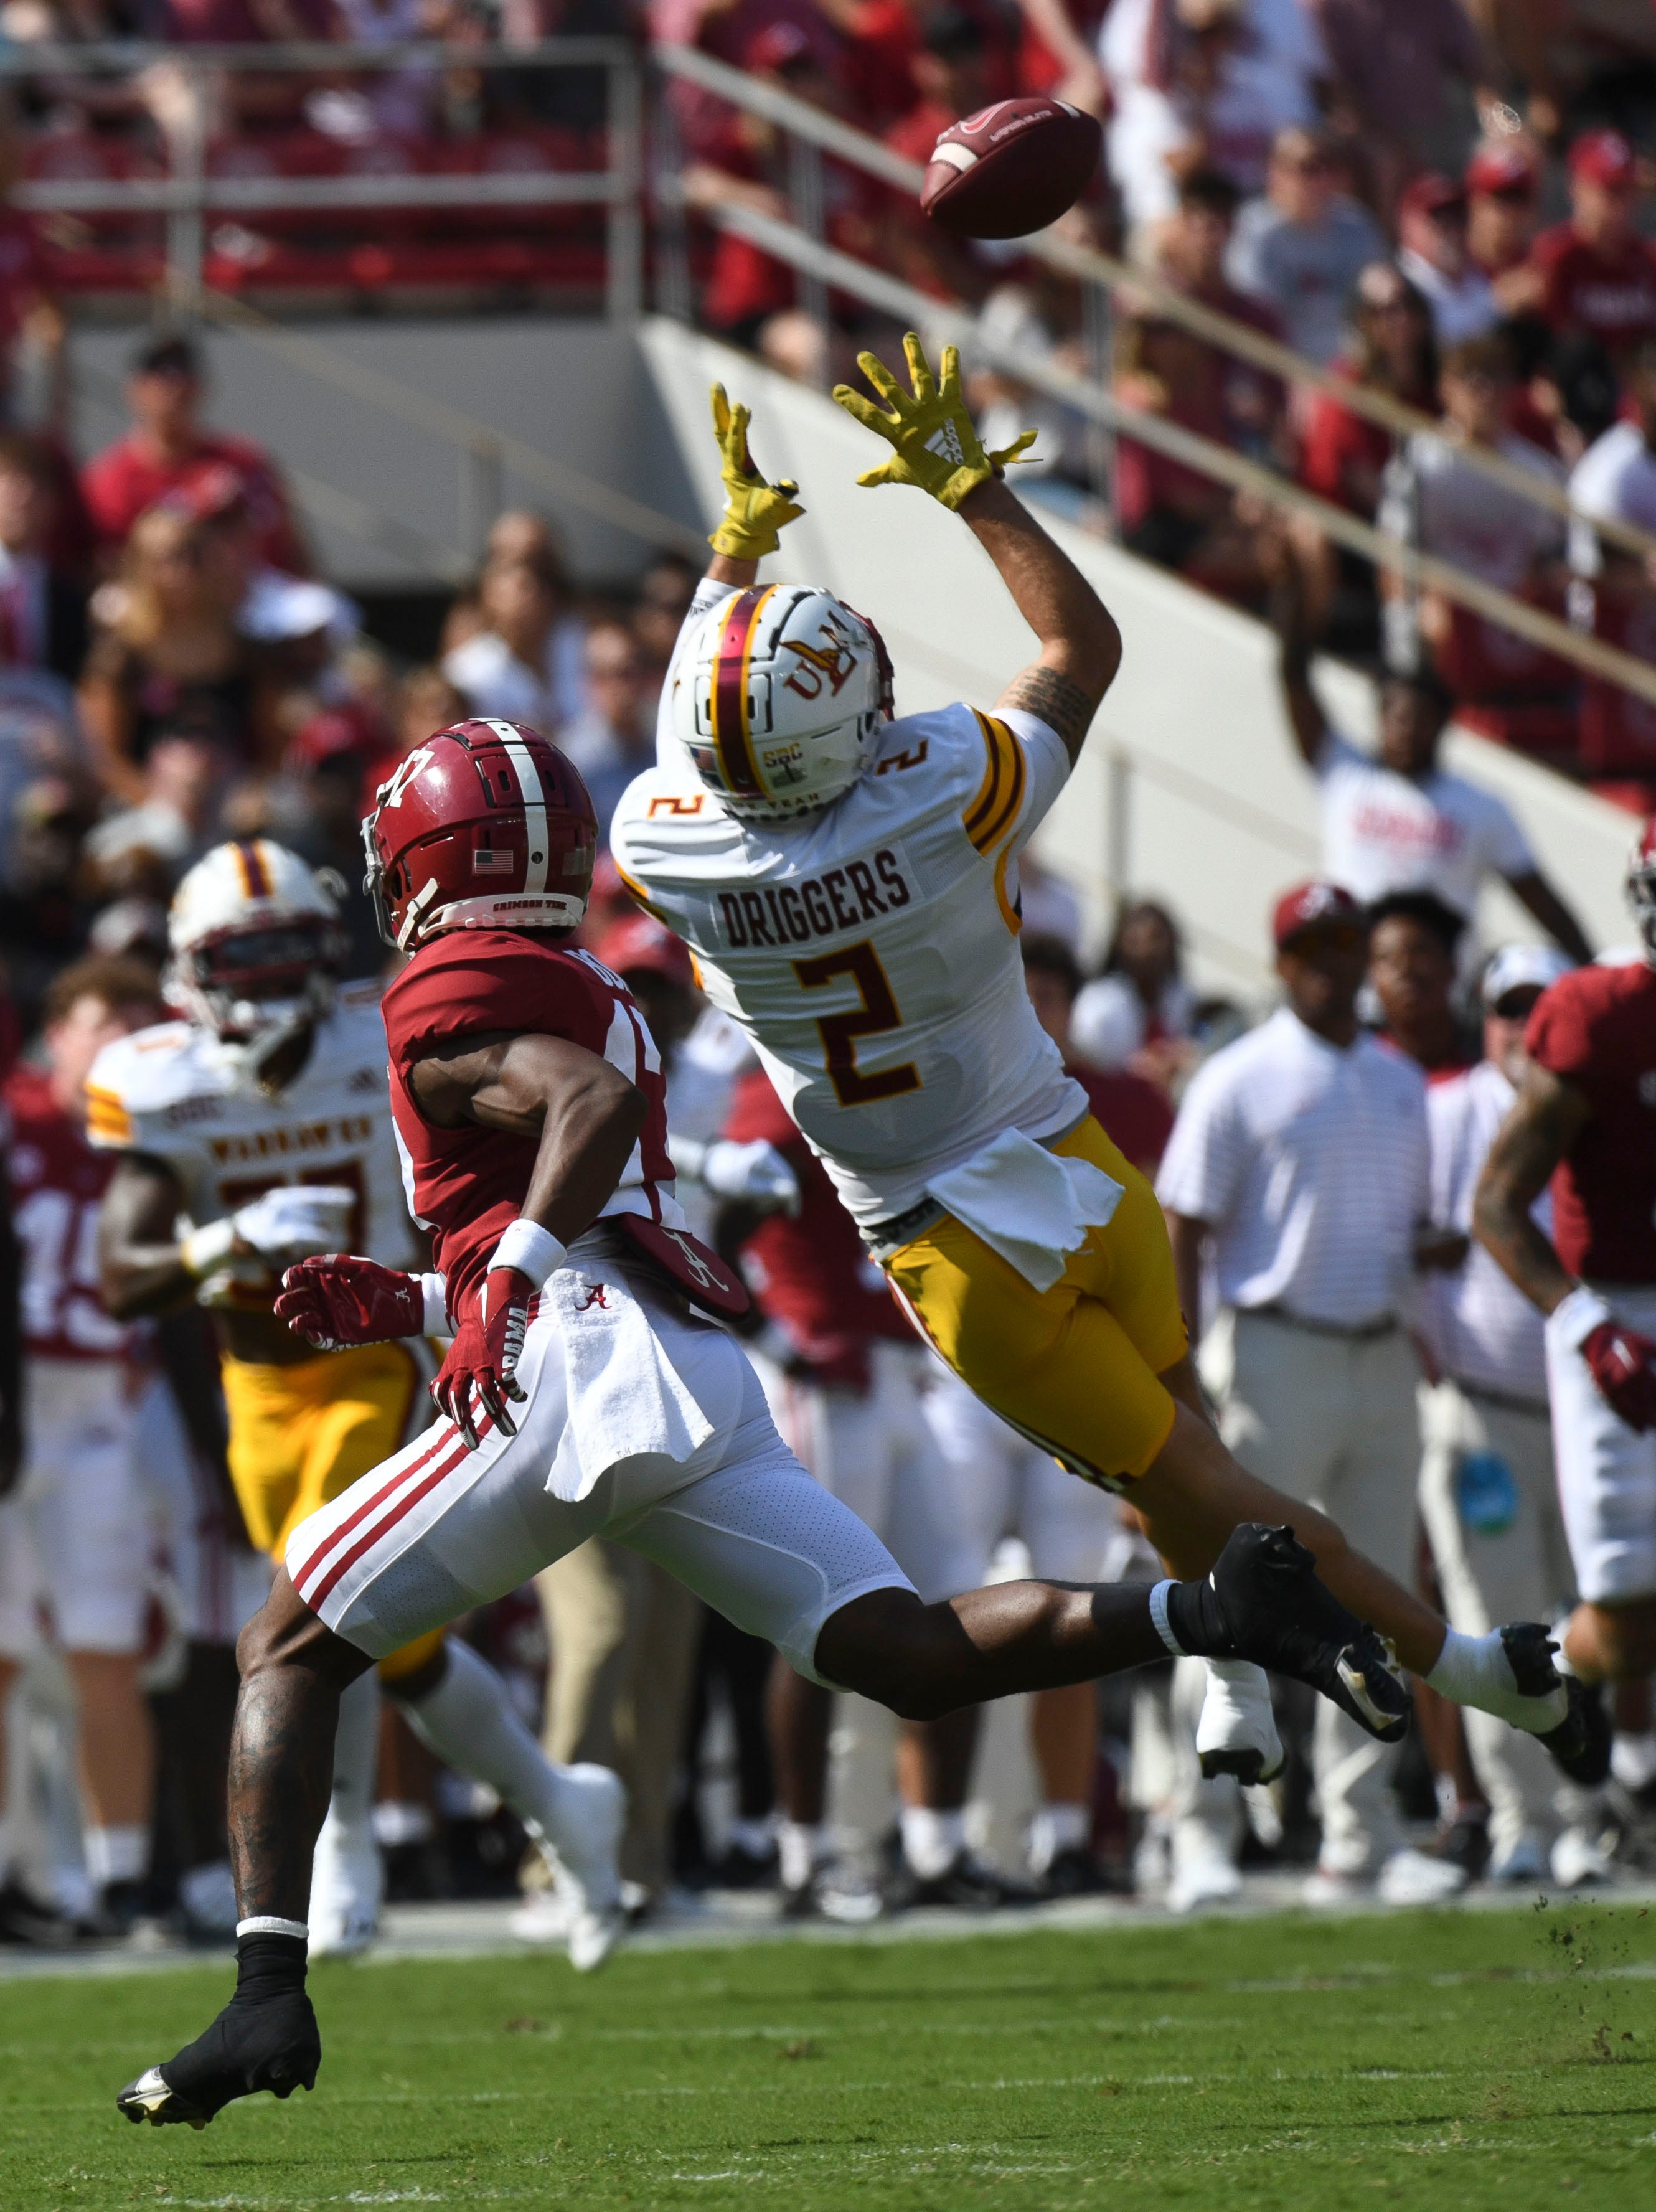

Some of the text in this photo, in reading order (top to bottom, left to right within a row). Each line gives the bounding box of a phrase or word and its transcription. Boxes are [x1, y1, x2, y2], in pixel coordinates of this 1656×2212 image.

[875, 738, 929, 776] 2
[646, 794, 705, 819] 2
[717, 849, 910, 948] DRIGGERS
[791, 938, 923, 1108] 2
[573, 1282, 613, 1312] A
